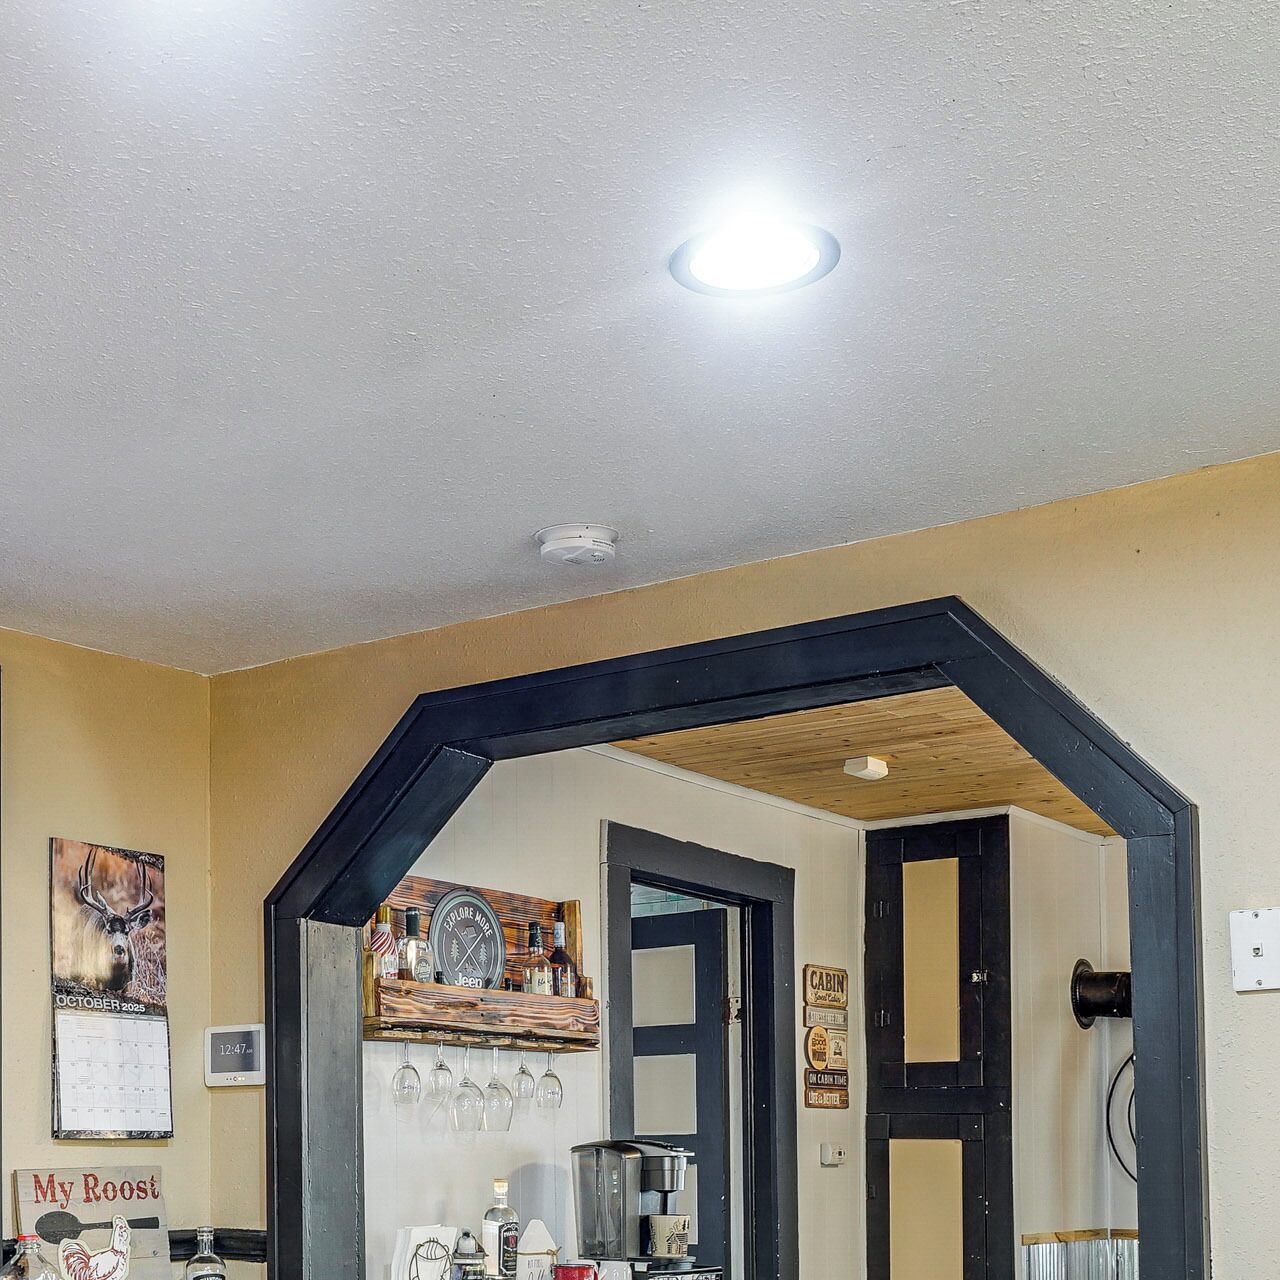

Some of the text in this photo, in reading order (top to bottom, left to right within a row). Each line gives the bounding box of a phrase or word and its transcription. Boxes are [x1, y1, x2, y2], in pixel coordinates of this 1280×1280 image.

[444, 906, 493, 938] EXPLORE MORE
[810, 970, 844, 993] CABIN
[56, 995, 145, 1013] OCTOBER 2025
[220, 1044, 246, 1055] 12:47
[809, 1073, 847, 1085] ON CABIN TIME
[33, 1173, 160, 1209] My Roost
